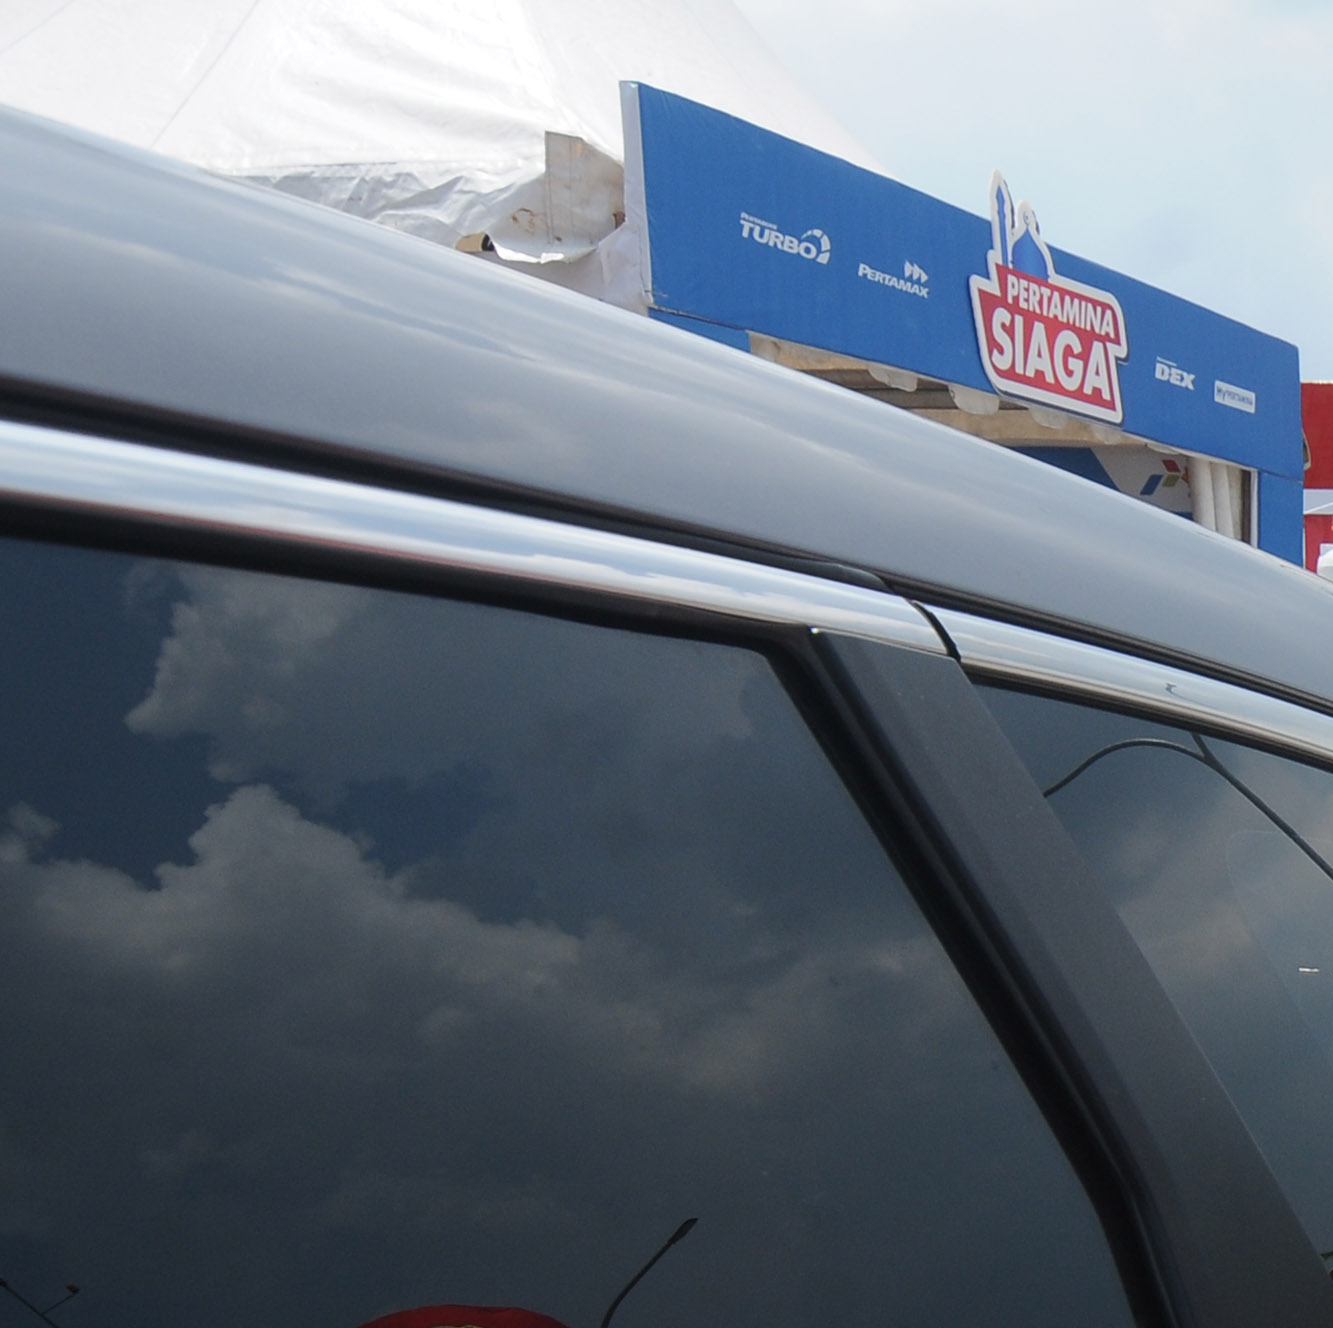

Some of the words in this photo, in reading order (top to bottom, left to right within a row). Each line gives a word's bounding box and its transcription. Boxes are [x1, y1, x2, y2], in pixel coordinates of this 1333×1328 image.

[739, 219, 818, 260] TURBO
[857, 262, 930, 299] PERTAMAX
[1006, 273, 1116, 340] PERTAMINA
[991, 307, 1112, 401] SIAGA
[1155, 362, 1196, 391] DEX
